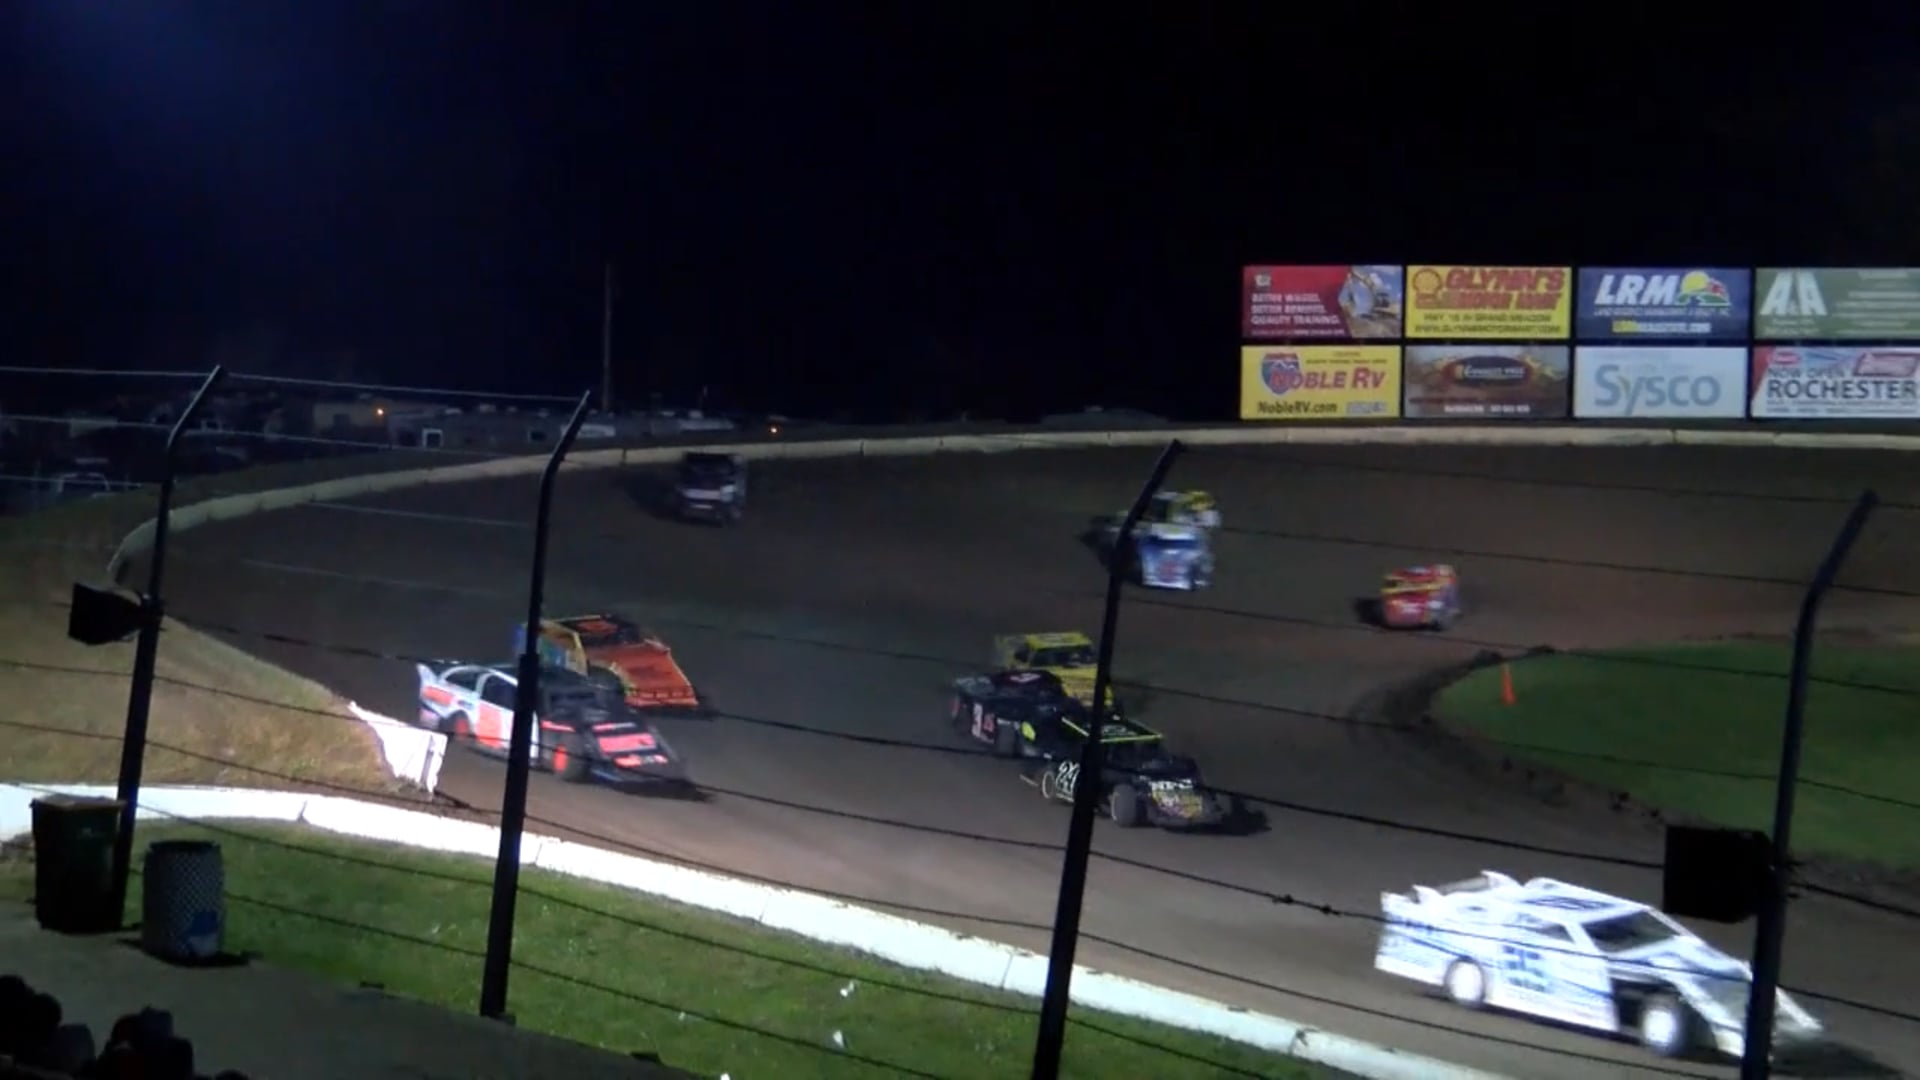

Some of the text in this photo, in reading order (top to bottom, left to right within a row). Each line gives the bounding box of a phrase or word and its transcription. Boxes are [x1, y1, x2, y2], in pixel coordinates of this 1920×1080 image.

[1594, 274, 1681, 305] LRM
[1270, 370, 1348, 390] NOBLE
[1594, 364, 1722, 416] Sysco
[1767, 379, 1917, 399] ROCHESTER
[1257, 401, 1338, 414] NobleRV.com
